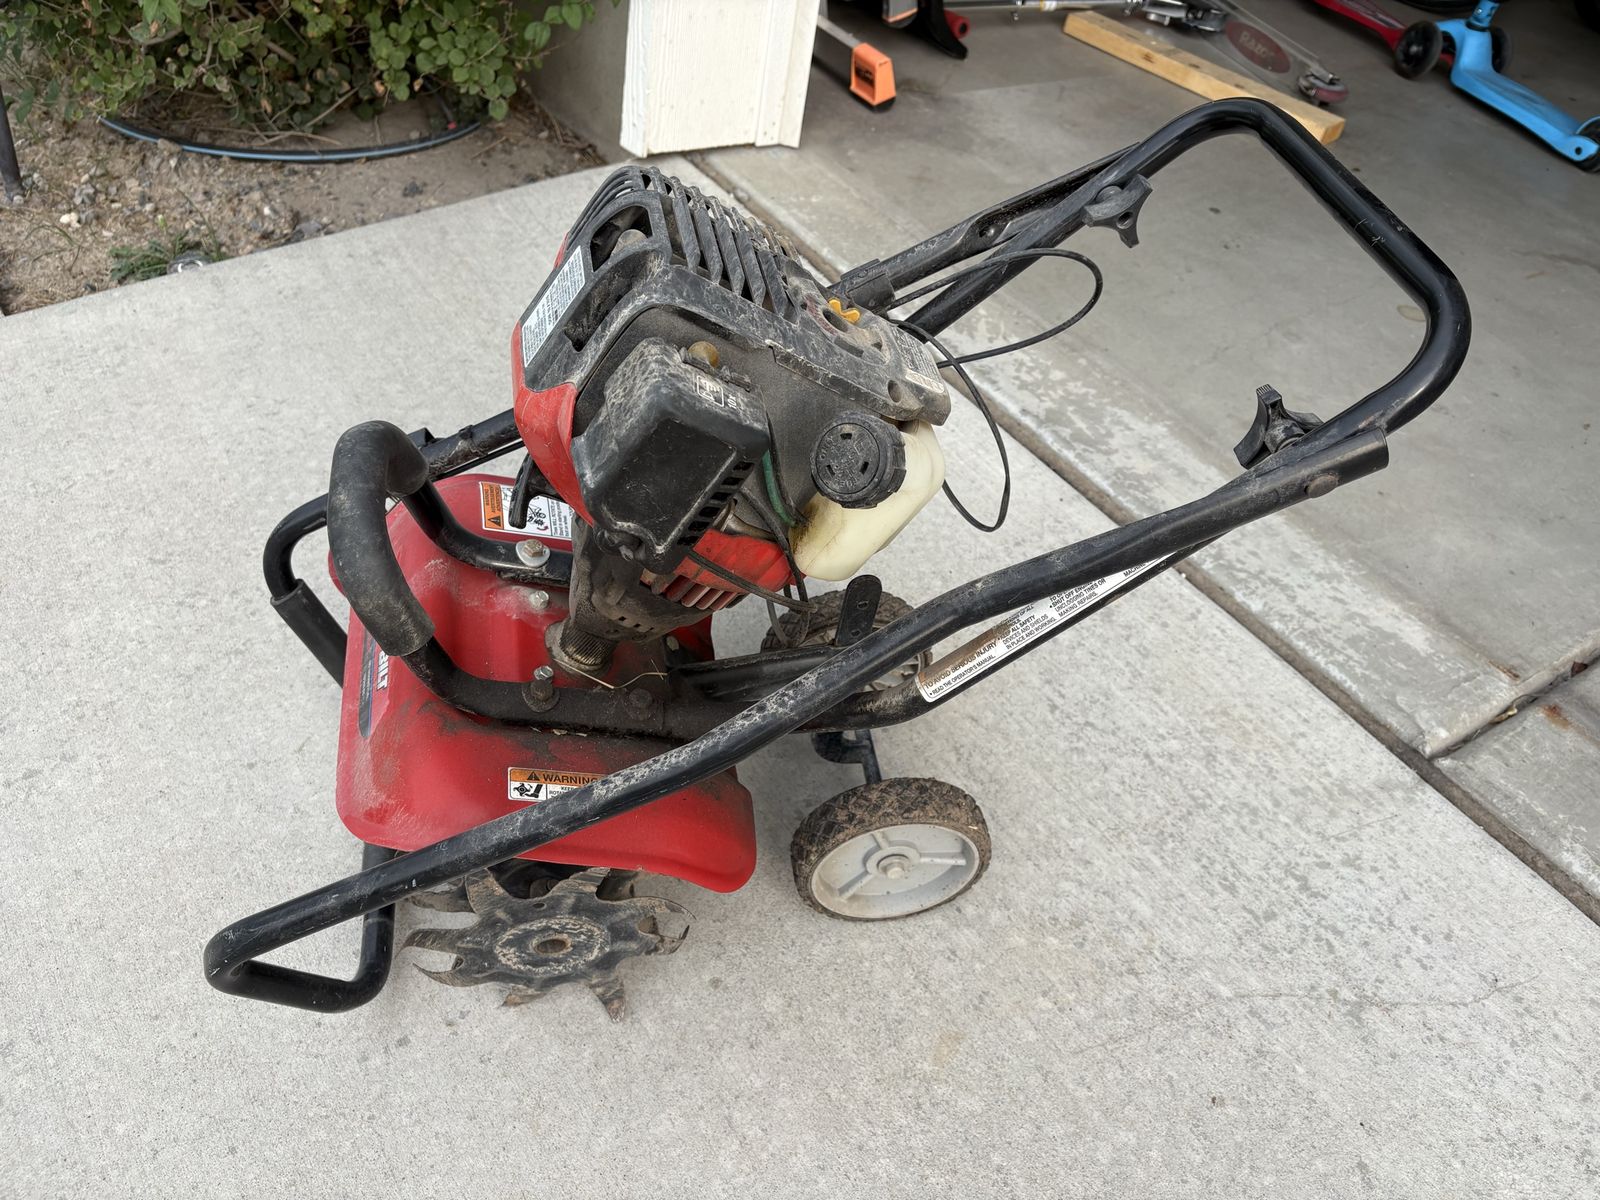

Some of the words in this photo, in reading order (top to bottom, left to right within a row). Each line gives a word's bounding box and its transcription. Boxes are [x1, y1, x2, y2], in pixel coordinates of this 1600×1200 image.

[1052, 597, 1065, 607] SHUT
[1065, 590, 1075, 599] OFF
[1054, 592, 1085, 612] UNCLOGGING
[1084, 583, 1098, 594] TINES
[1058, 603, 1078, 617] MAKING
[1077, 591, 1098, 606] REPAIRS.
[1002, 631, 1021, 644] DEVICES
[1021, 625, 1030, 634] AND
[1030, 614, 1048, 628] SHIELDS
[1011, 635, 1026, 646] PLACE
[1025, 629, 1035, 638] AND
[1034, 617, 1056, 632] WORKING.
[1019, 614, 1035, 627] SAFETY
[924, 681, 934, 689] TO
[934, 670, 951, 684] AVOID
[951, 655, 976, 673] SERIOUS
[976, 640, 997, 658] INJURY
[932, 685, 944, 695] READ
[943, 679, 952, 688] THE
[952, 664, 978, 683] OPERATOR'S
[976, 654, 997, 667] MANUAL.
